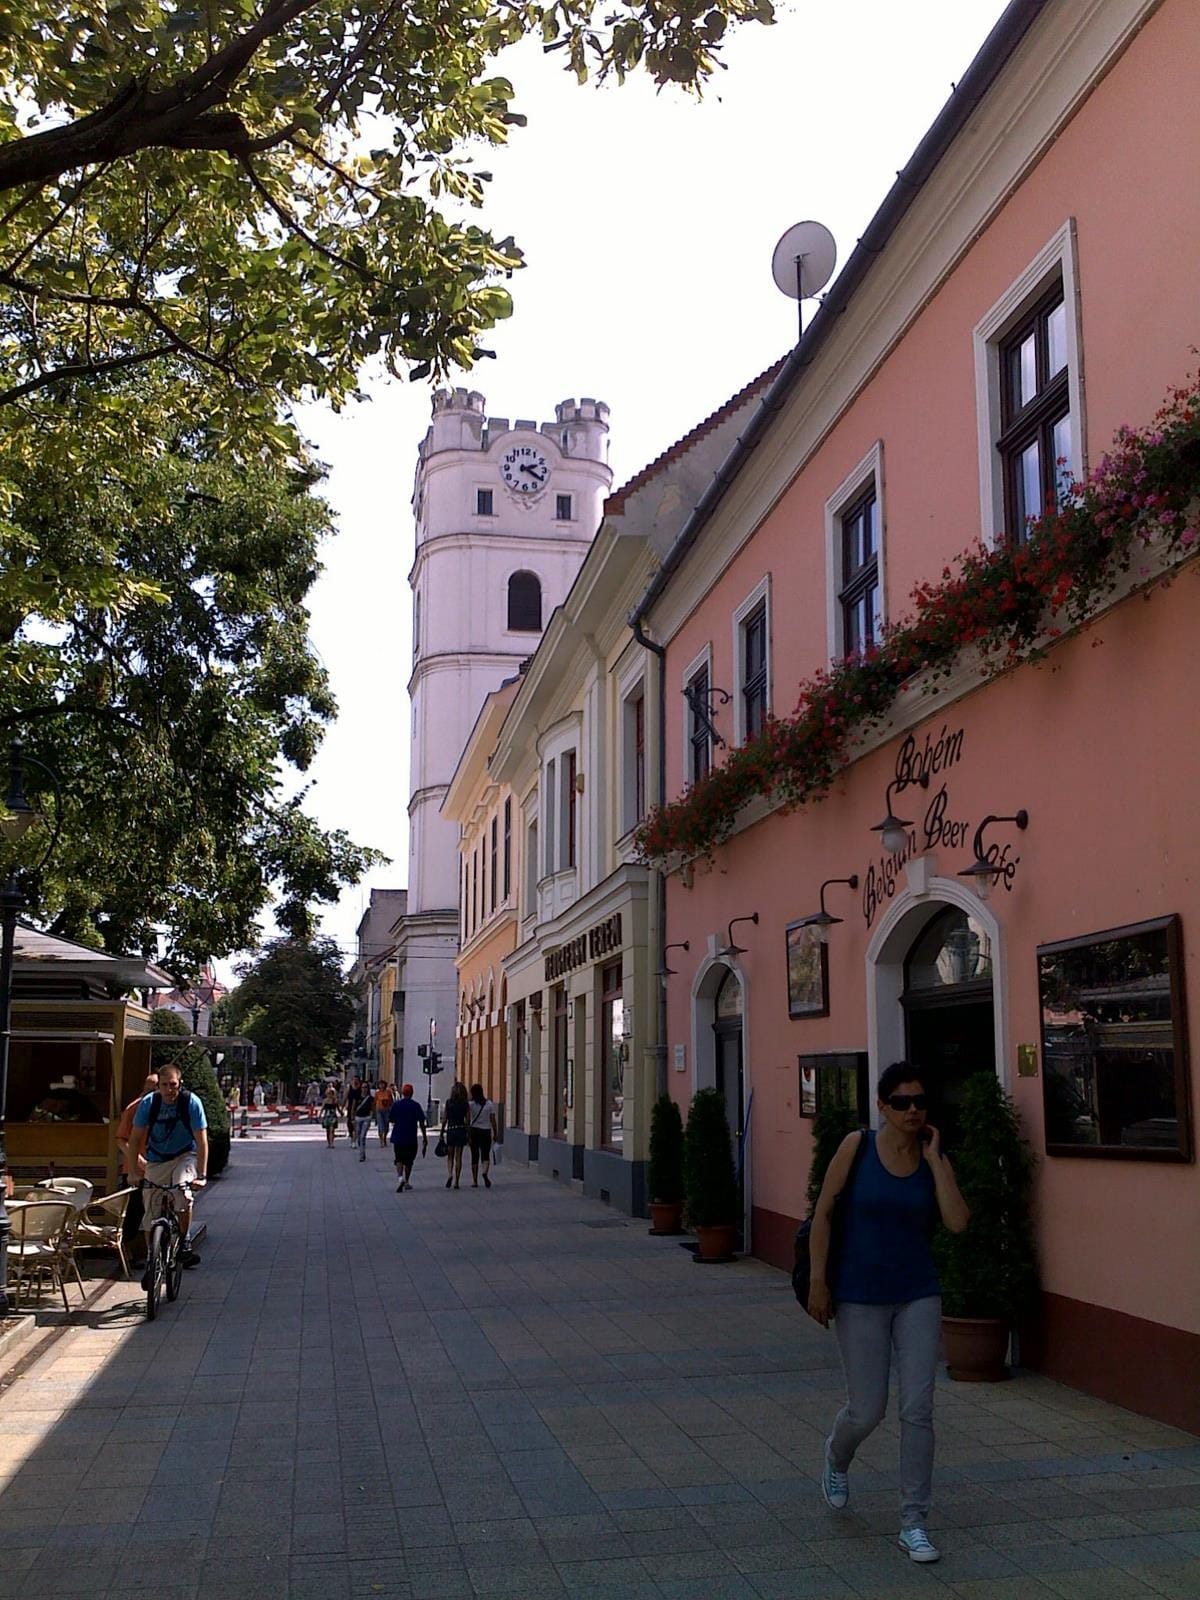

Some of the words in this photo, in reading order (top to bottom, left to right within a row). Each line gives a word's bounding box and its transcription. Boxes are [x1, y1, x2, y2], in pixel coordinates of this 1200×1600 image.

[521, 448, 531, 456] 12
[506, 455, 515, 463] 10
[513, 480, 519, 488] 7
[522, 483, 528, 491] 6
[895, 724, 964, 794] Bohém
[923, 782, 970, 850] Beer
